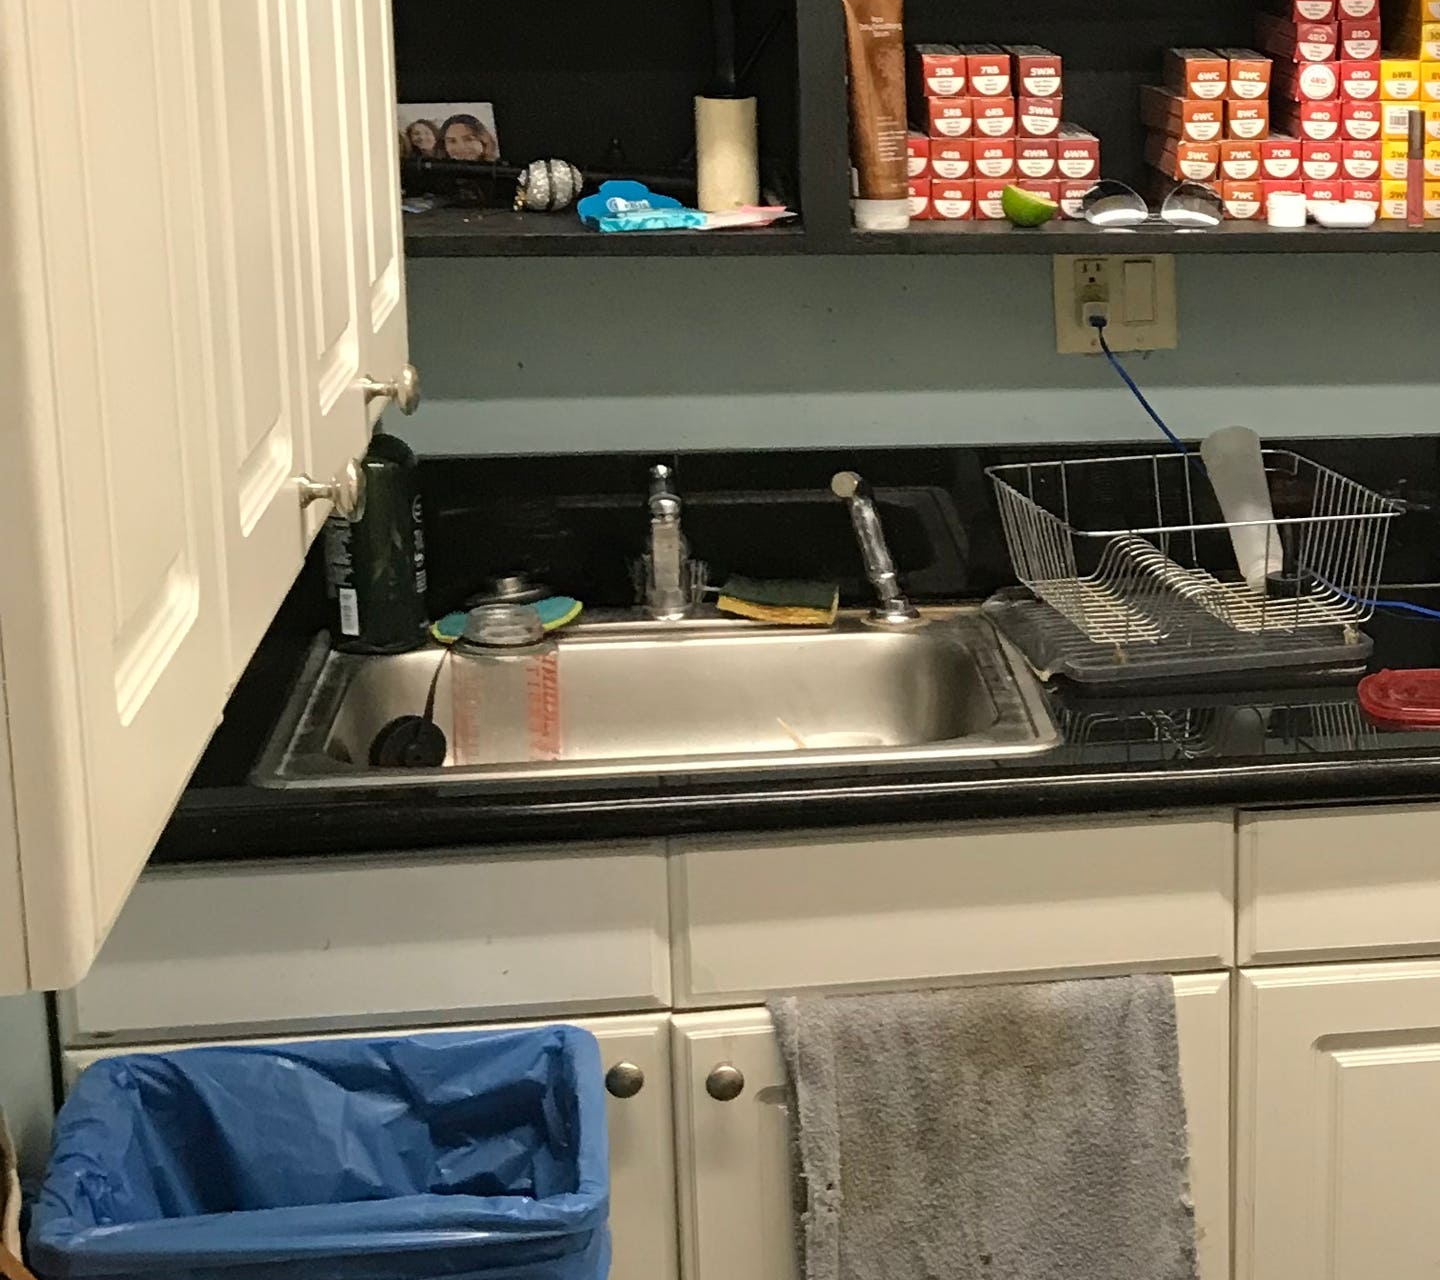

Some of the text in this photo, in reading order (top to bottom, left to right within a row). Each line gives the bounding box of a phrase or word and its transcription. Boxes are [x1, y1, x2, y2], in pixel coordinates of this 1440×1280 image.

[1198, 72, 1219, 81] 6WC
[1238, 71, 1260, 80] 8WC
[1351, 71, 1371, 80] 6RO
[1192, 112, 1214, 121] 6WC
[1311, 112, 1330, 121] 4RO
[1353, 110, 1372, 120] 6RO
[1230, 151, 1251, 160] 7WC
[1311, 152, 1330, 161] 4RO
[1232, 191, 1254, 200] 7WC
[1313, 190, 1332, 199] 4RO
